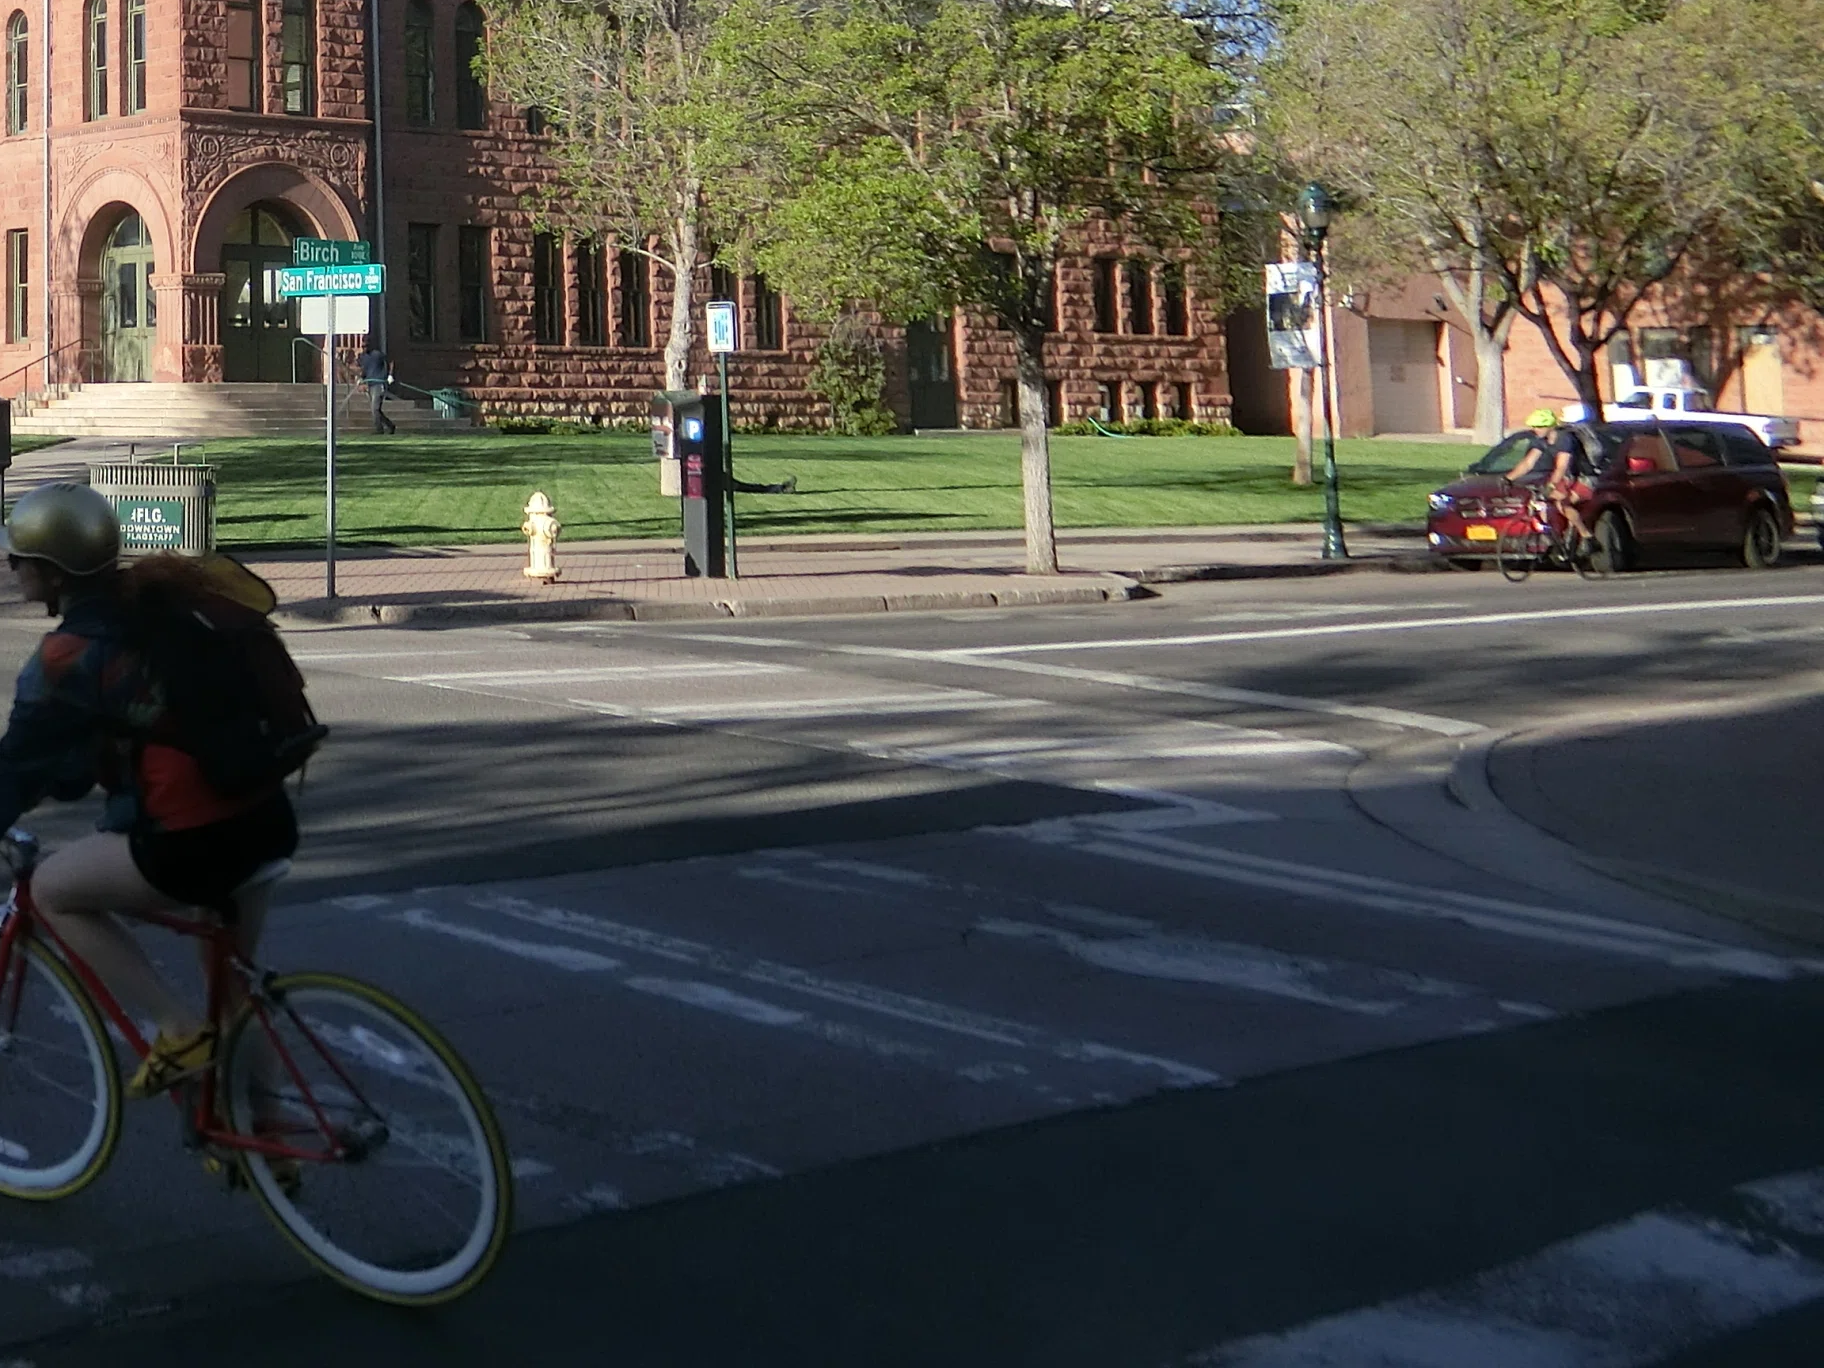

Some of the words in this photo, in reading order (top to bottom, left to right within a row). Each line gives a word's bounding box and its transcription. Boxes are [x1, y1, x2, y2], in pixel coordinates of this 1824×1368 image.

[300, 241, 339, 263] Birch
[282, 271, 303, 292] San
[306, 269, 363, 291] Francisco
[689, 419, 700, 441] P
[136, 507, 167, 523] FLG.
[119, 524, 181, 535] DOWNTOWN
[126, 532, 174, 542] FLAGSTAFF
